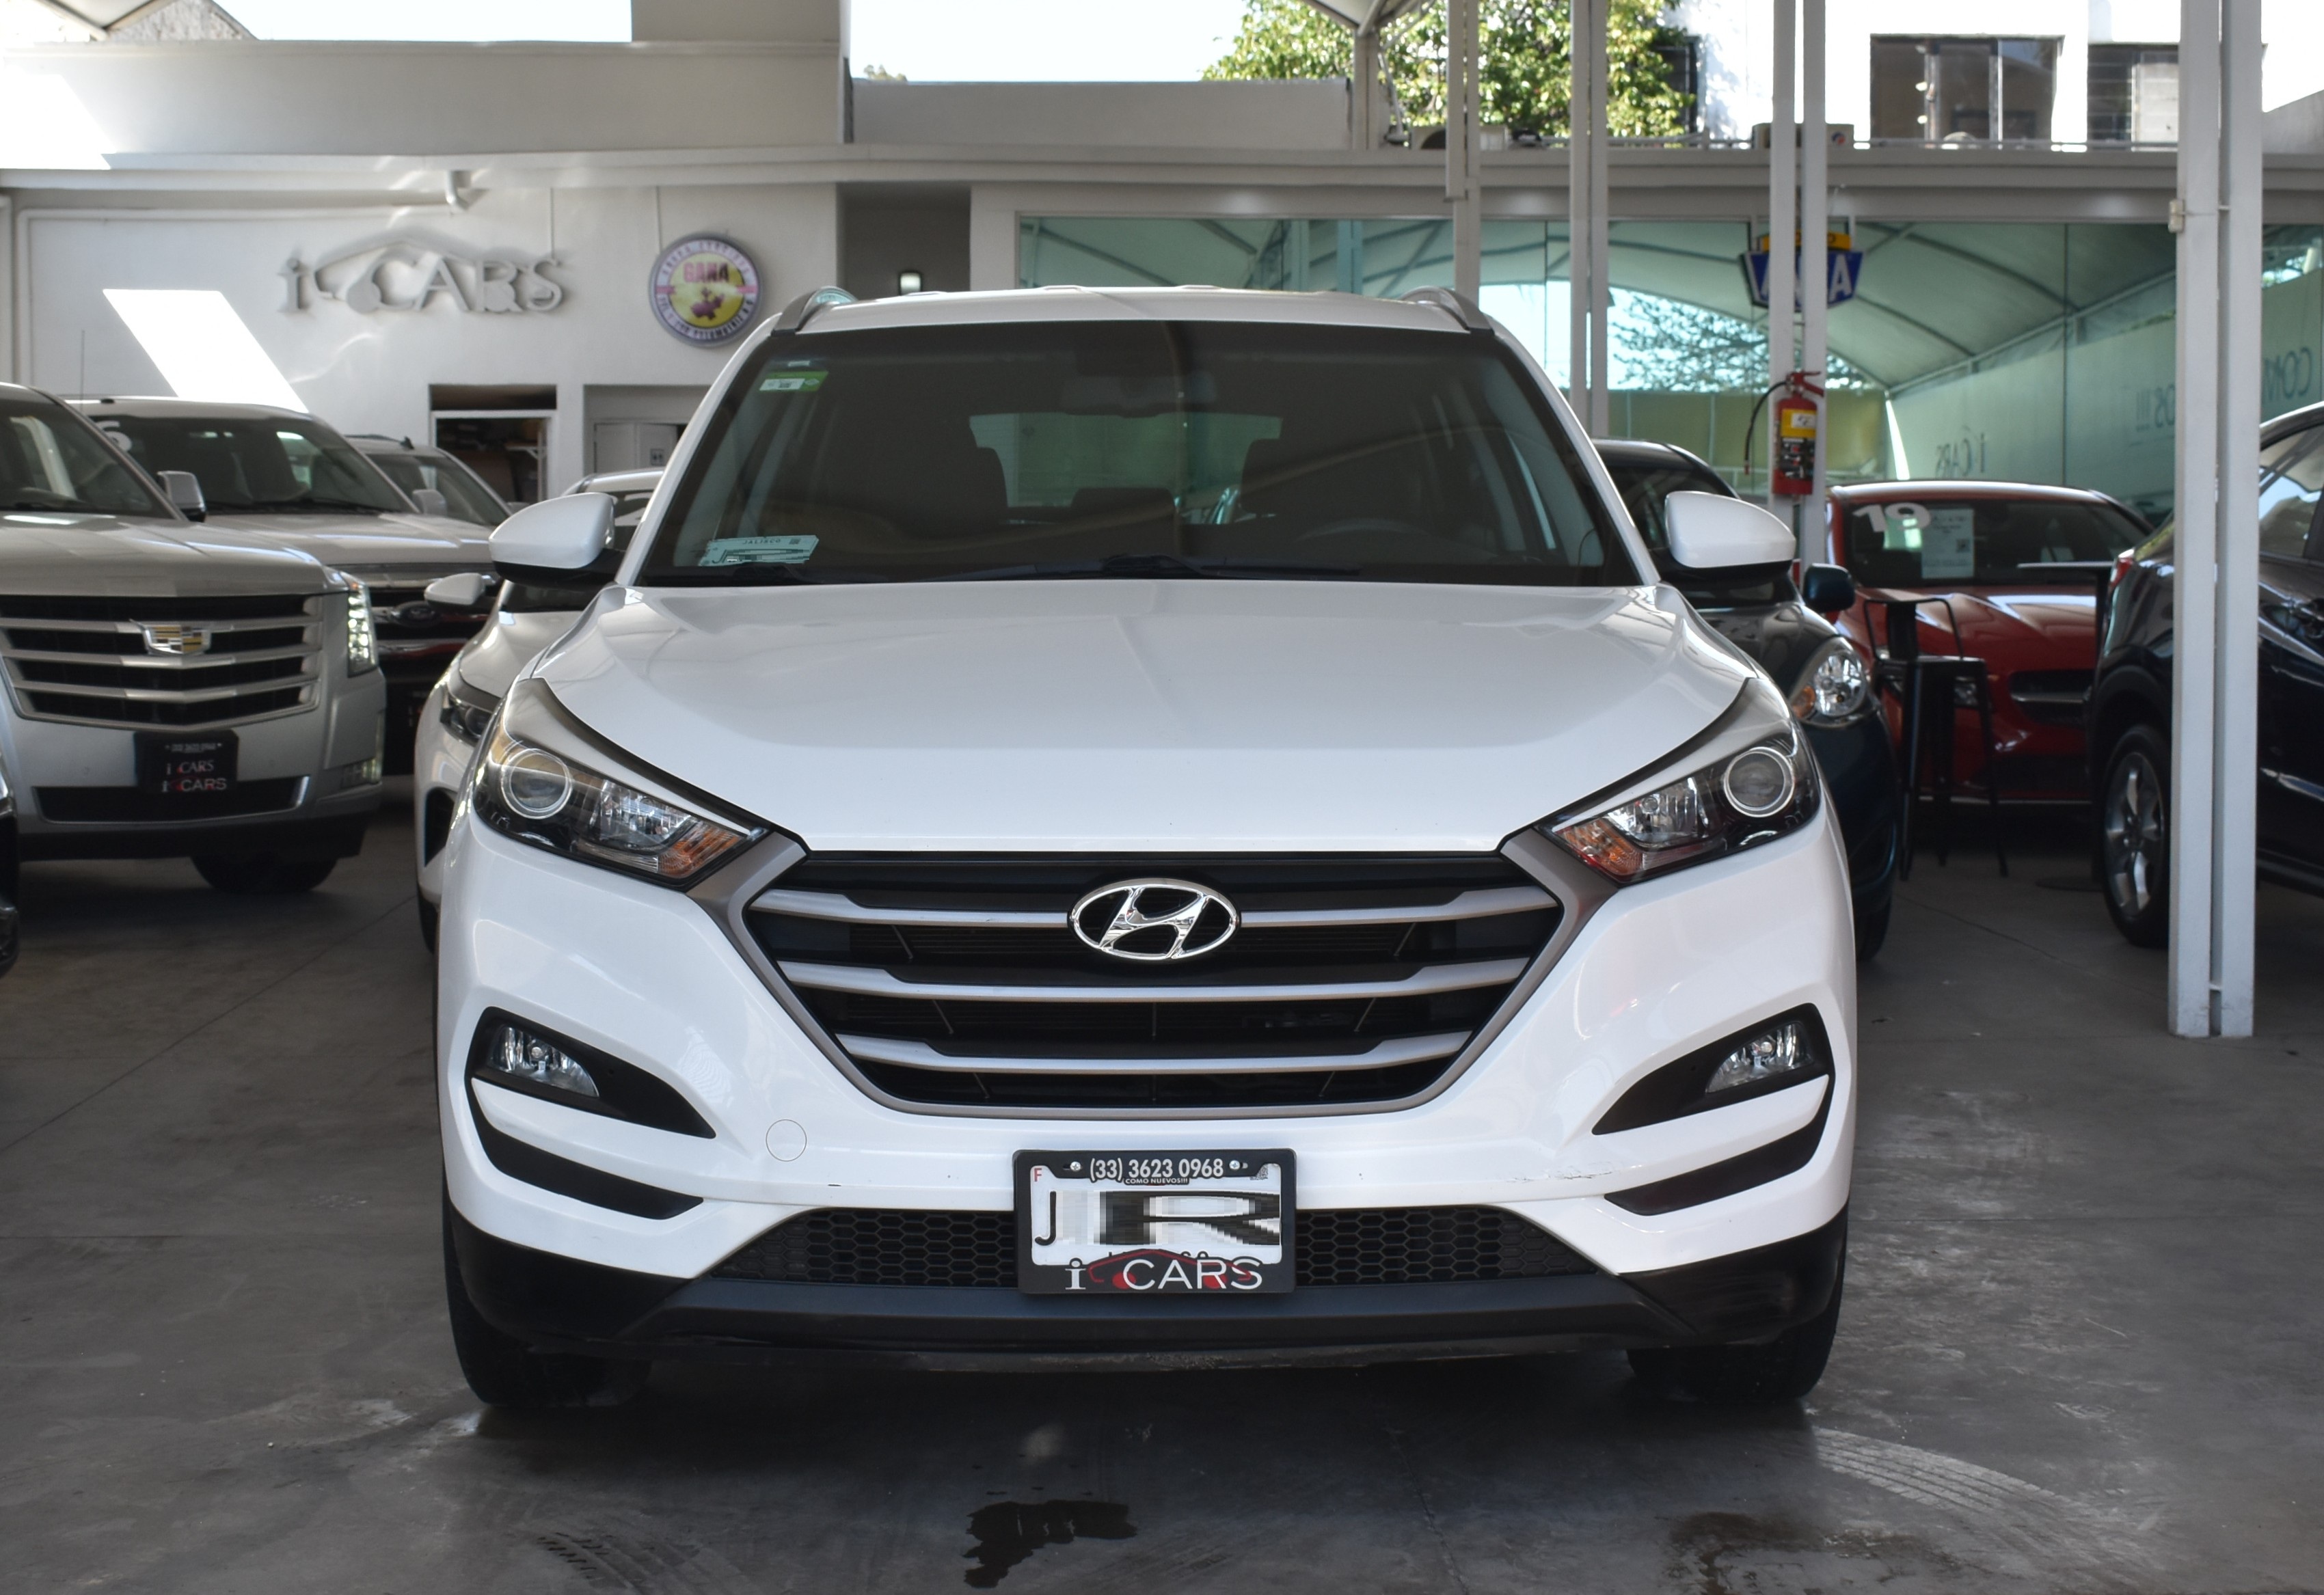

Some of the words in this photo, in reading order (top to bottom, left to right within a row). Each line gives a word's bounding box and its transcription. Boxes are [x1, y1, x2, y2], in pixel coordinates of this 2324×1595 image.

[277, 257, 312, 312] i
[362, 254, 563, 312] CARS
[683, 262, 729, 282] GANA
[1852, 502, 1932, 532] 19
[180, 760, 215, 773] CARS
[180, 777, 227, 791] CARS
[1034, 1168, 1042, 1182] F
[1090, 1158, 1122, 1182] (33)
[1129, 1159, 1173, 1178] 3623
[1178, 1158, 1224, 1177] 0968
[1065, 1259, 1087, 1290] i
[1122, 1257, 1263, 1290] CARS
